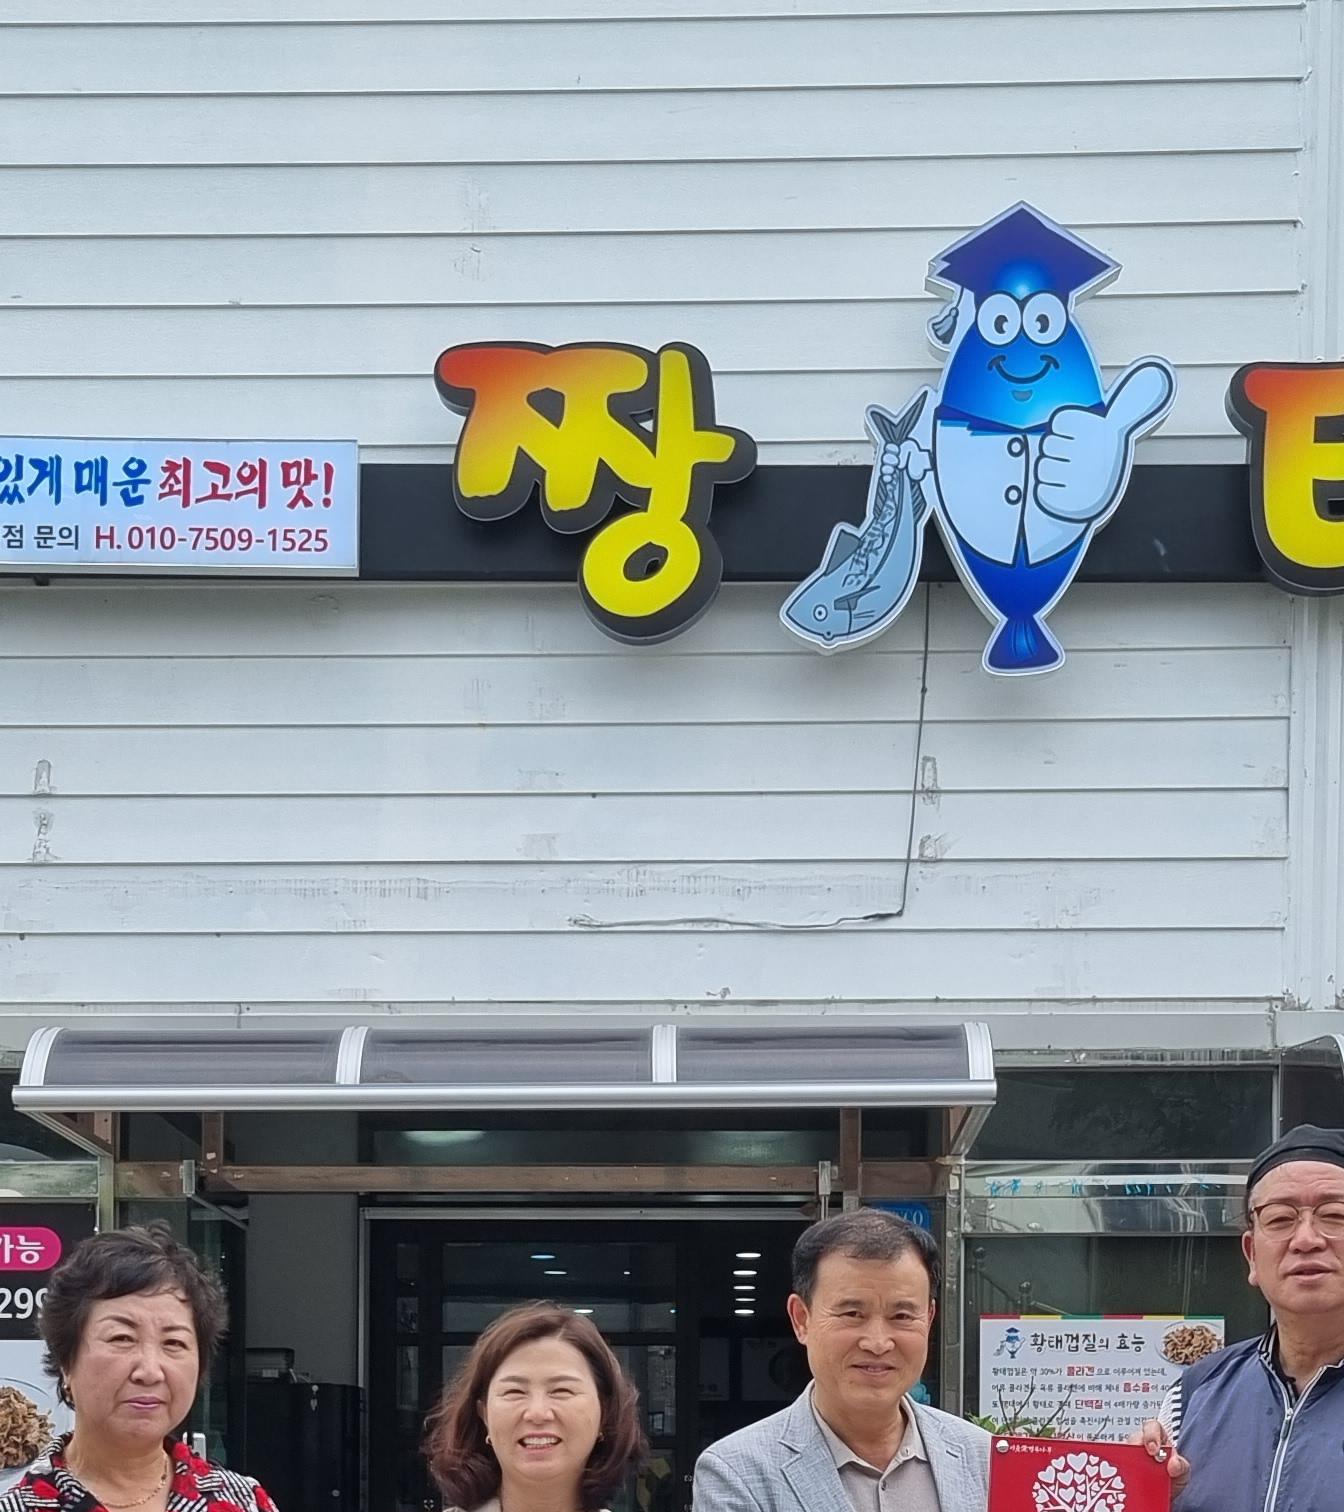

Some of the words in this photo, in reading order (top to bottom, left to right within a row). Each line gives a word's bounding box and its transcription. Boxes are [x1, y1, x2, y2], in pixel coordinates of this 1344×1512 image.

[74, 456, 151, 507] 매운
[158, 457, 266, 508] 최고의
[280, 458, 335, 510] 맛!
[437, 342, 756, 644] 짱
[34, 524, 80, 550] 문의
[1029, 1331, 1110, 1353] 황태껍질의
[1116, 1332, 1146, 1353] 효능
